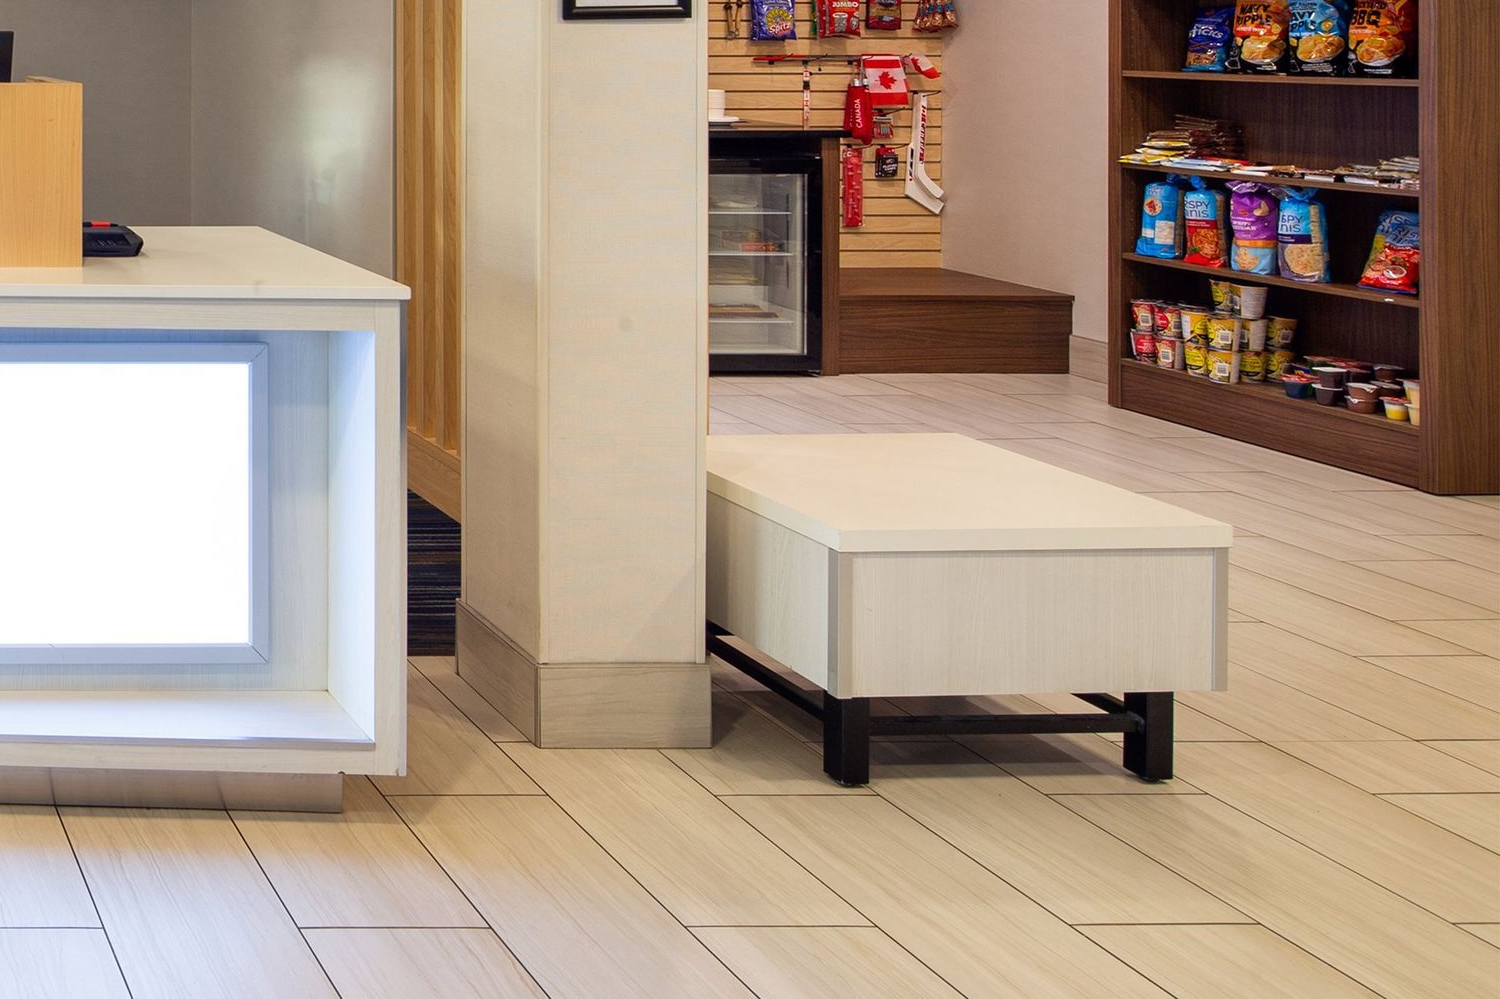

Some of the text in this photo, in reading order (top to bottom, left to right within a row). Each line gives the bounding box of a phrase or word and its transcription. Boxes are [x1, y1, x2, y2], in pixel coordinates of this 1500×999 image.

[1292, 10, 1316, 21] AVY
[769, 22, 790, 34] Spitz
[854, 98, 863, 129] CANADA
